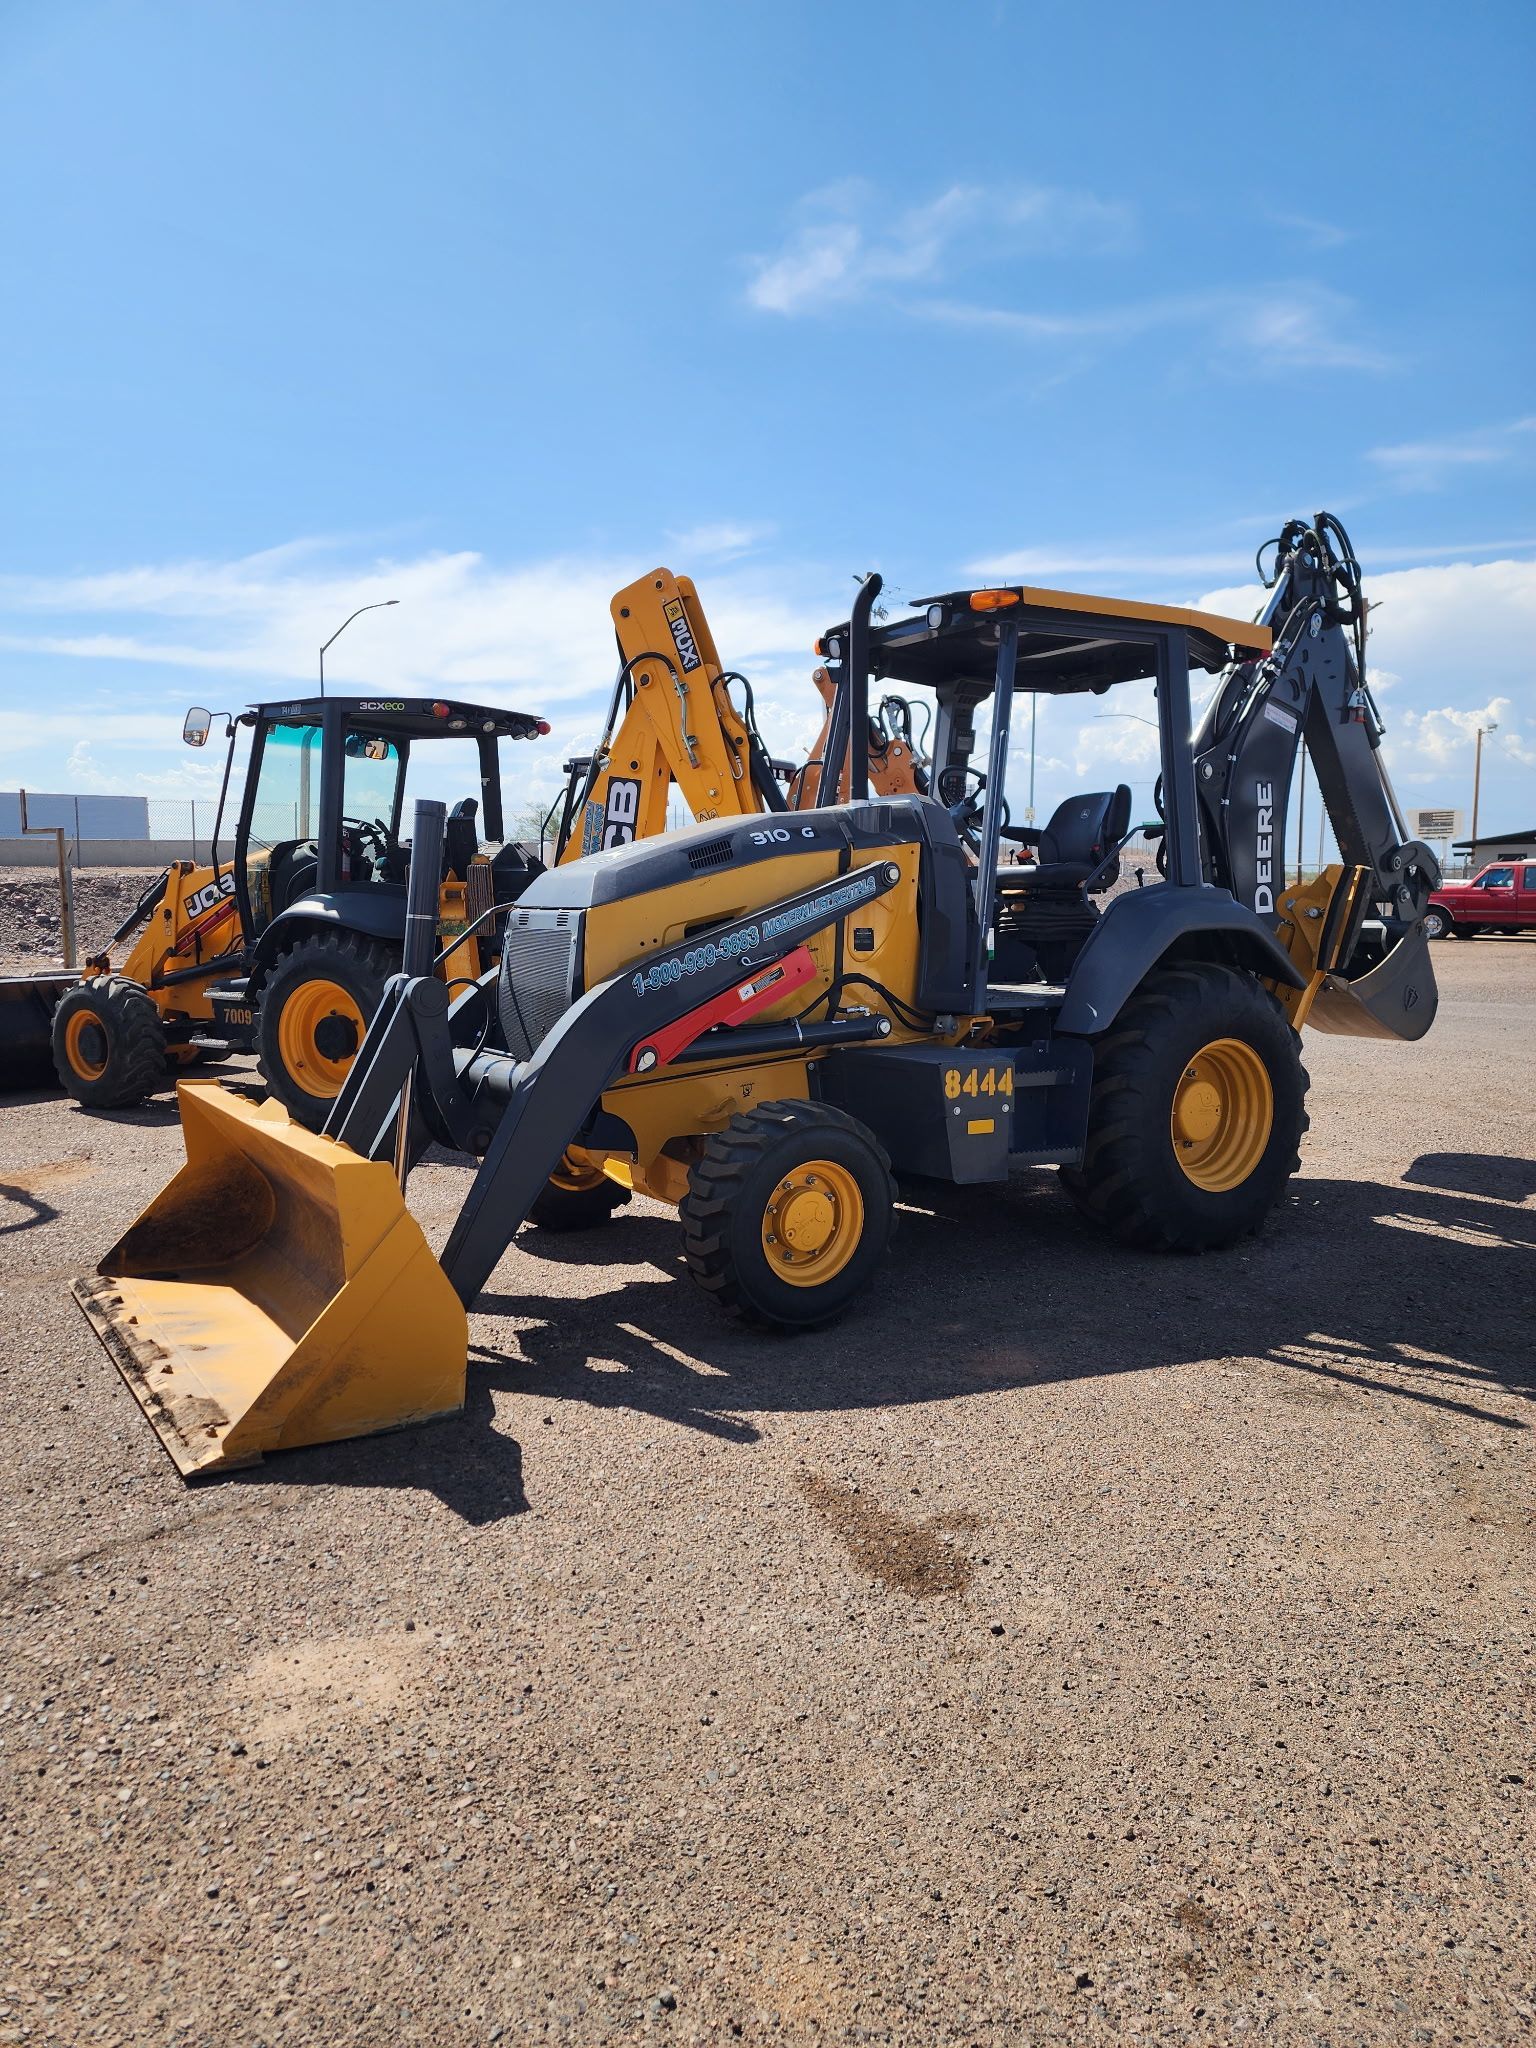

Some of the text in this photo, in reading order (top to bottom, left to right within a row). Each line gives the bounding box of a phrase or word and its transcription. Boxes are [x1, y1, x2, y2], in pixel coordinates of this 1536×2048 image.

[672, 618, 699, 665] 3CX
[749, 826, 815, 845] 310 G
[1255, 783, 1274, 914] DEERE
[188, 873, 237, 918] JCB
[632, 926, 760, 997] 1-800-999-3883
[223, 1008, 252, 1025] 7009
[944, 1067, 1014, 1100] 8444
